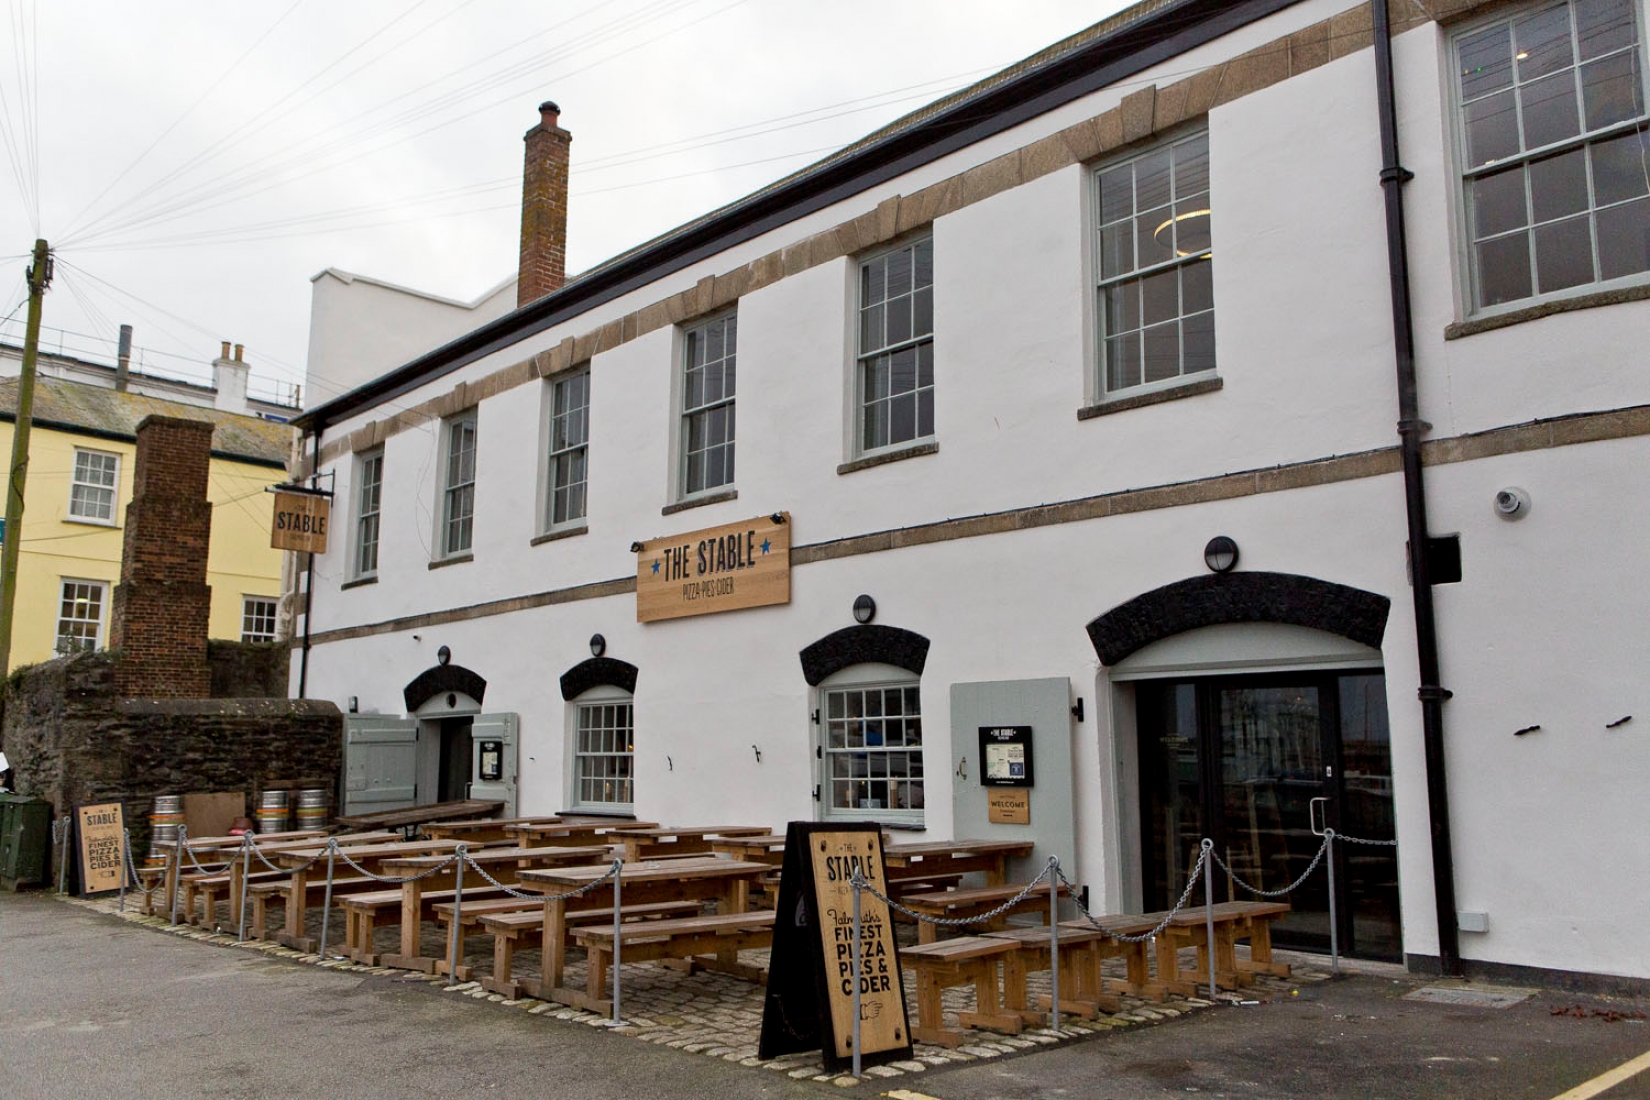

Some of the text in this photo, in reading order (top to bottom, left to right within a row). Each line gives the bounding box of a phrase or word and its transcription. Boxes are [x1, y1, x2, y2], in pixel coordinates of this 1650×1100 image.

[277, 511, 326, 534] STABLE
[664, 530, 756, 582] THE STABLE
[87, 812, 117, 826] STABLE
[88, 840, 119, 849] FINEST
[89, 846, 120, 856] PIZZA
[844, 843, 853, 852] THE
[90, 854, 111, 862] PIES
[90, 860, 121, 870] CIDER
[827, 908, 882, 926] Falmuth's
[837, 941, 886, 961] PIZA
[839, 957, 888, 978] PIS &
[841, 975, 891, 996] CDER
